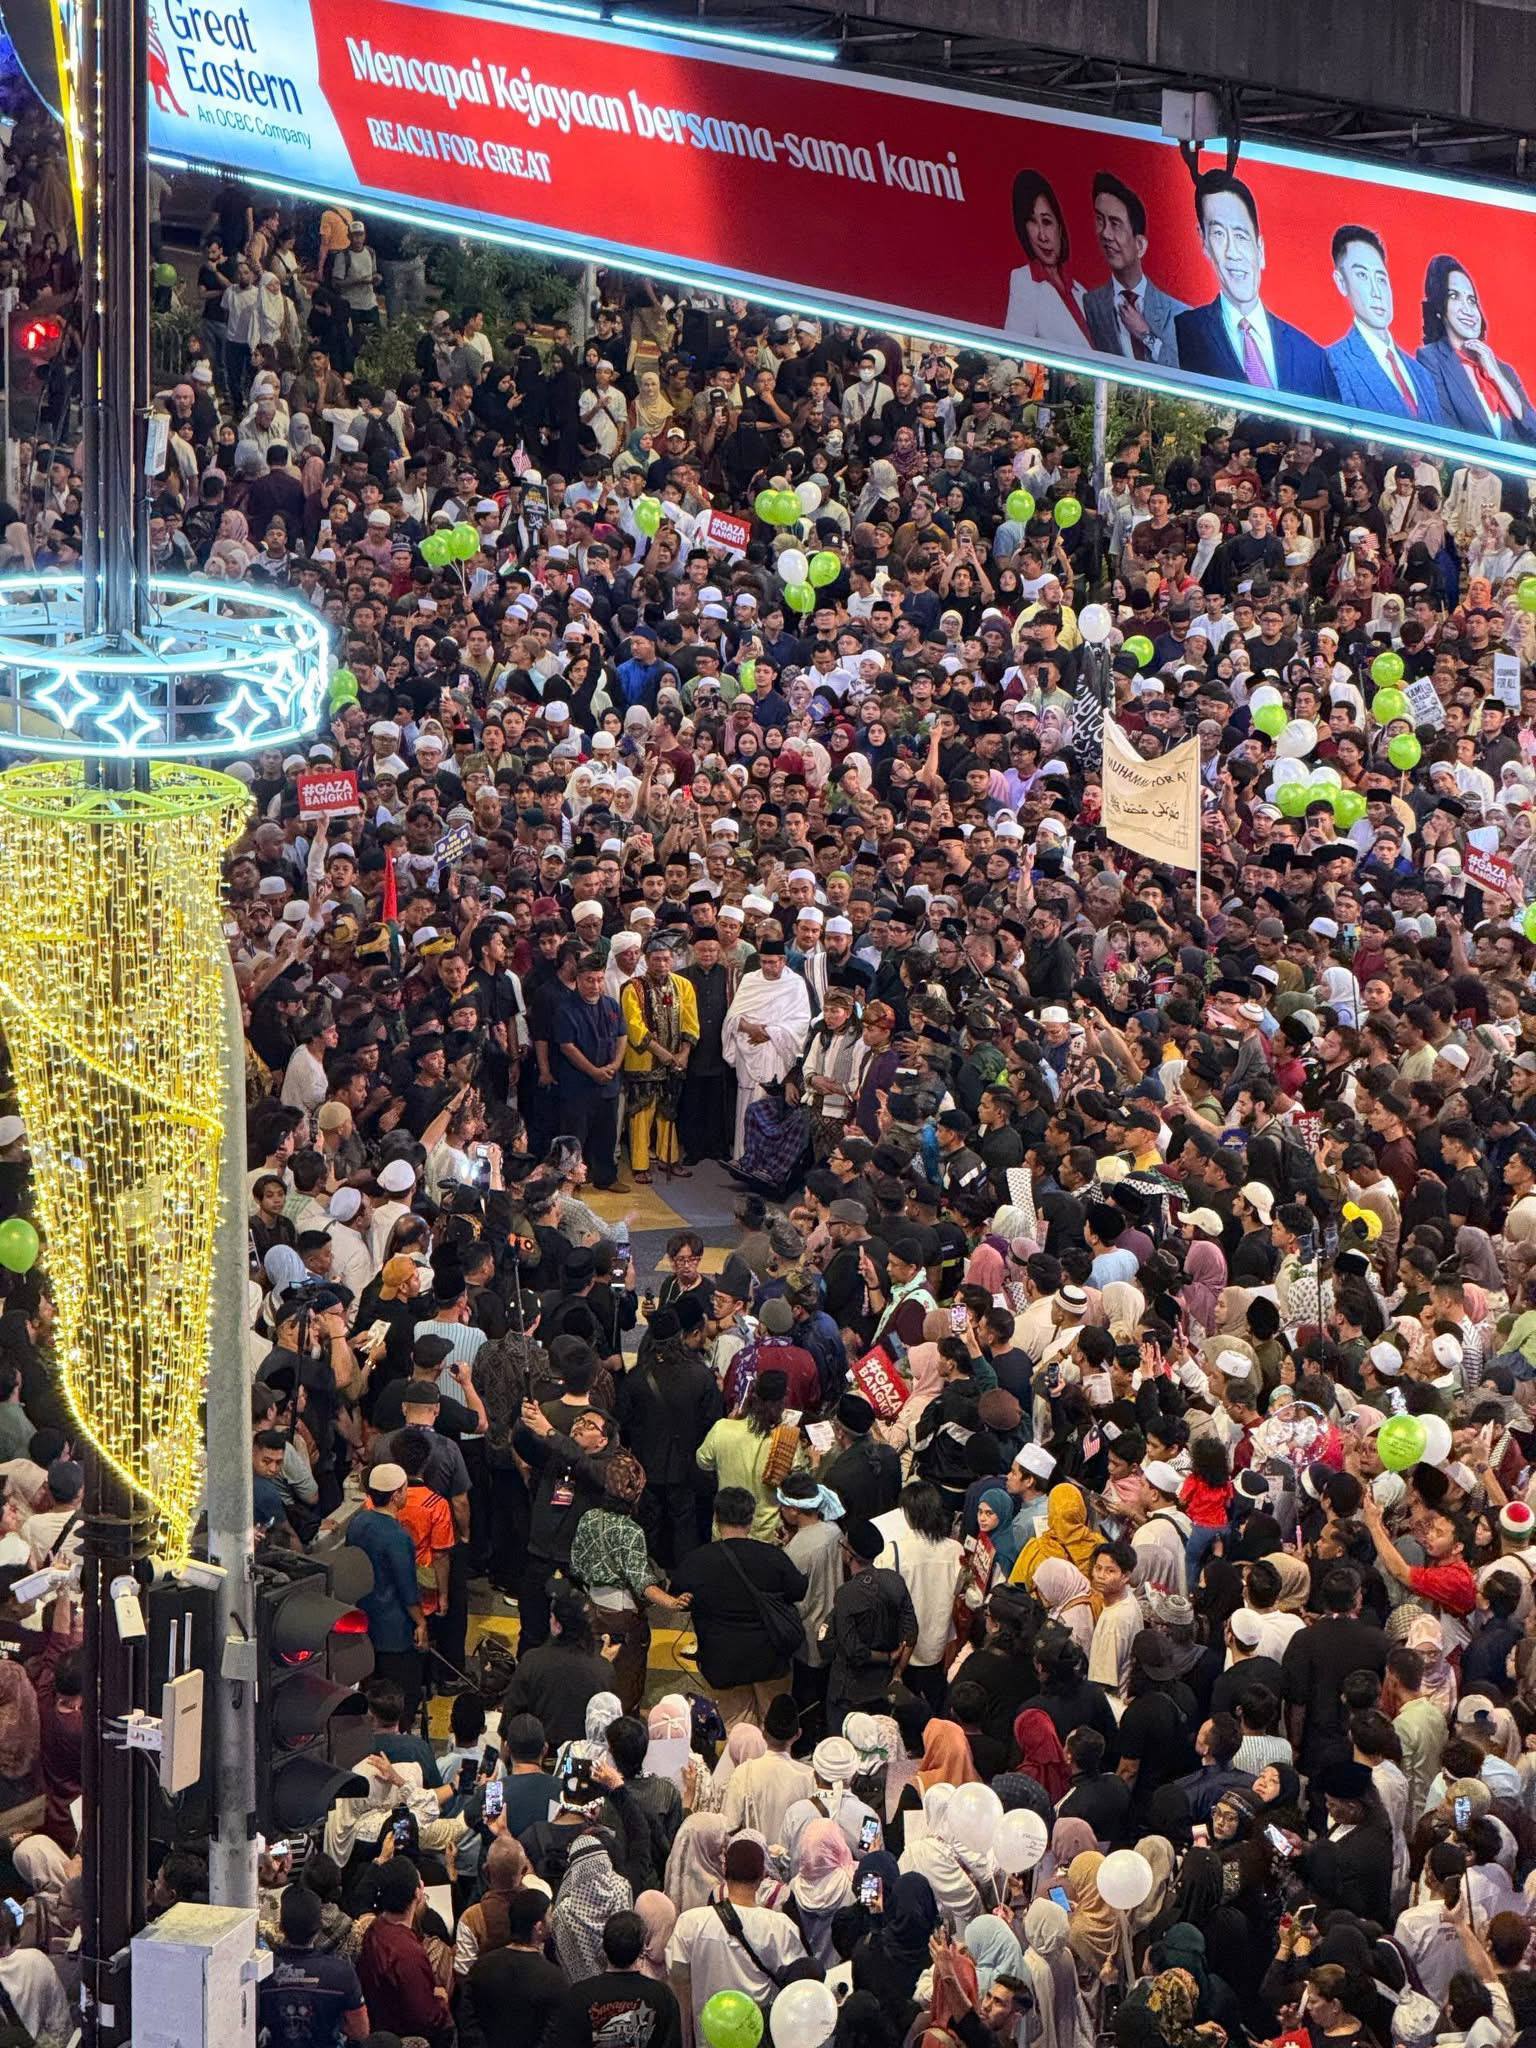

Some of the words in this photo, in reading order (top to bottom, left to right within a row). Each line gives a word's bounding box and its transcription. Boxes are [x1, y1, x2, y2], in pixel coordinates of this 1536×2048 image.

[165, 0, 257, 53] Great
[177, 46, 303, 115] Eastern
[198, 104, 215, 125] An
[216, 109, 254, 133] OCBC
[256, 117, 312, 150] Company
[345, 37, 490, 110] Mencapai
[488, 64, 631, 134] Kejayaan
[627, 89, 877, 182] bersama-sama
[877, 141, 965, 202] kami
[367, 117, 440, 160] REACH
[438, 132, 484, 169] FOR
[482, 141, 552, 184] GREAT
[711, 528, 744, 544] BANGKIT
[712, 518, 746, 538] #GAZA
[302, 779, 352, 797] #GAZA
[304, 791, 353, 806] BANGKIT
[1468, 854, 1507, 880] #GAZA
[1468, 865, 1506, 888] BANGKIT
[866, 1358, 903, 1413] #GAZA
